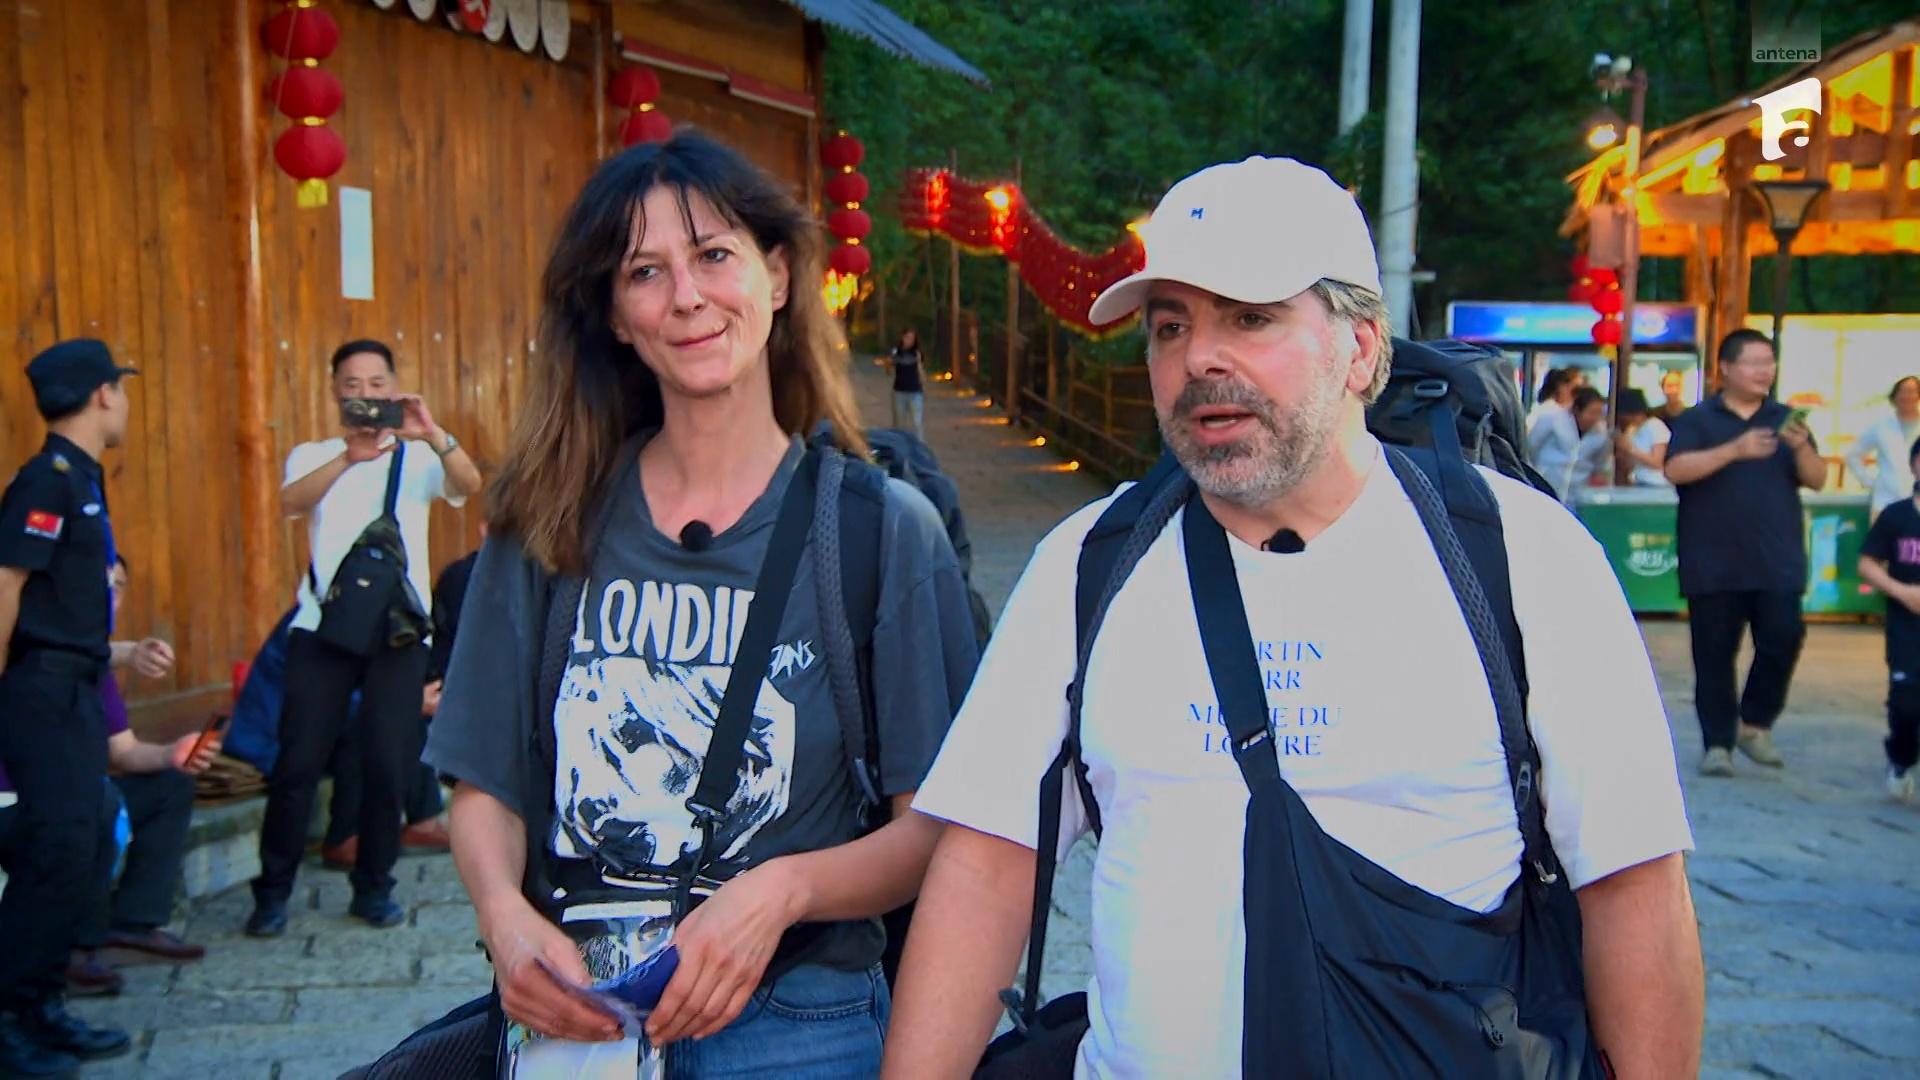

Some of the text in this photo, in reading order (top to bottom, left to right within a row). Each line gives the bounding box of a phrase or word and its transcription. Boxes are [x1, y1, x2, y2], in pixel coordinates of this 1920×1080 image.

[569, 577, 756, 665] LONDI
[1257, 640, 1325, 661] RTIN
[1265, 669, 1302, 690] RR
[1299, 706, 1344, 727] DU
[1203, 733, 1321, 756] LORE
